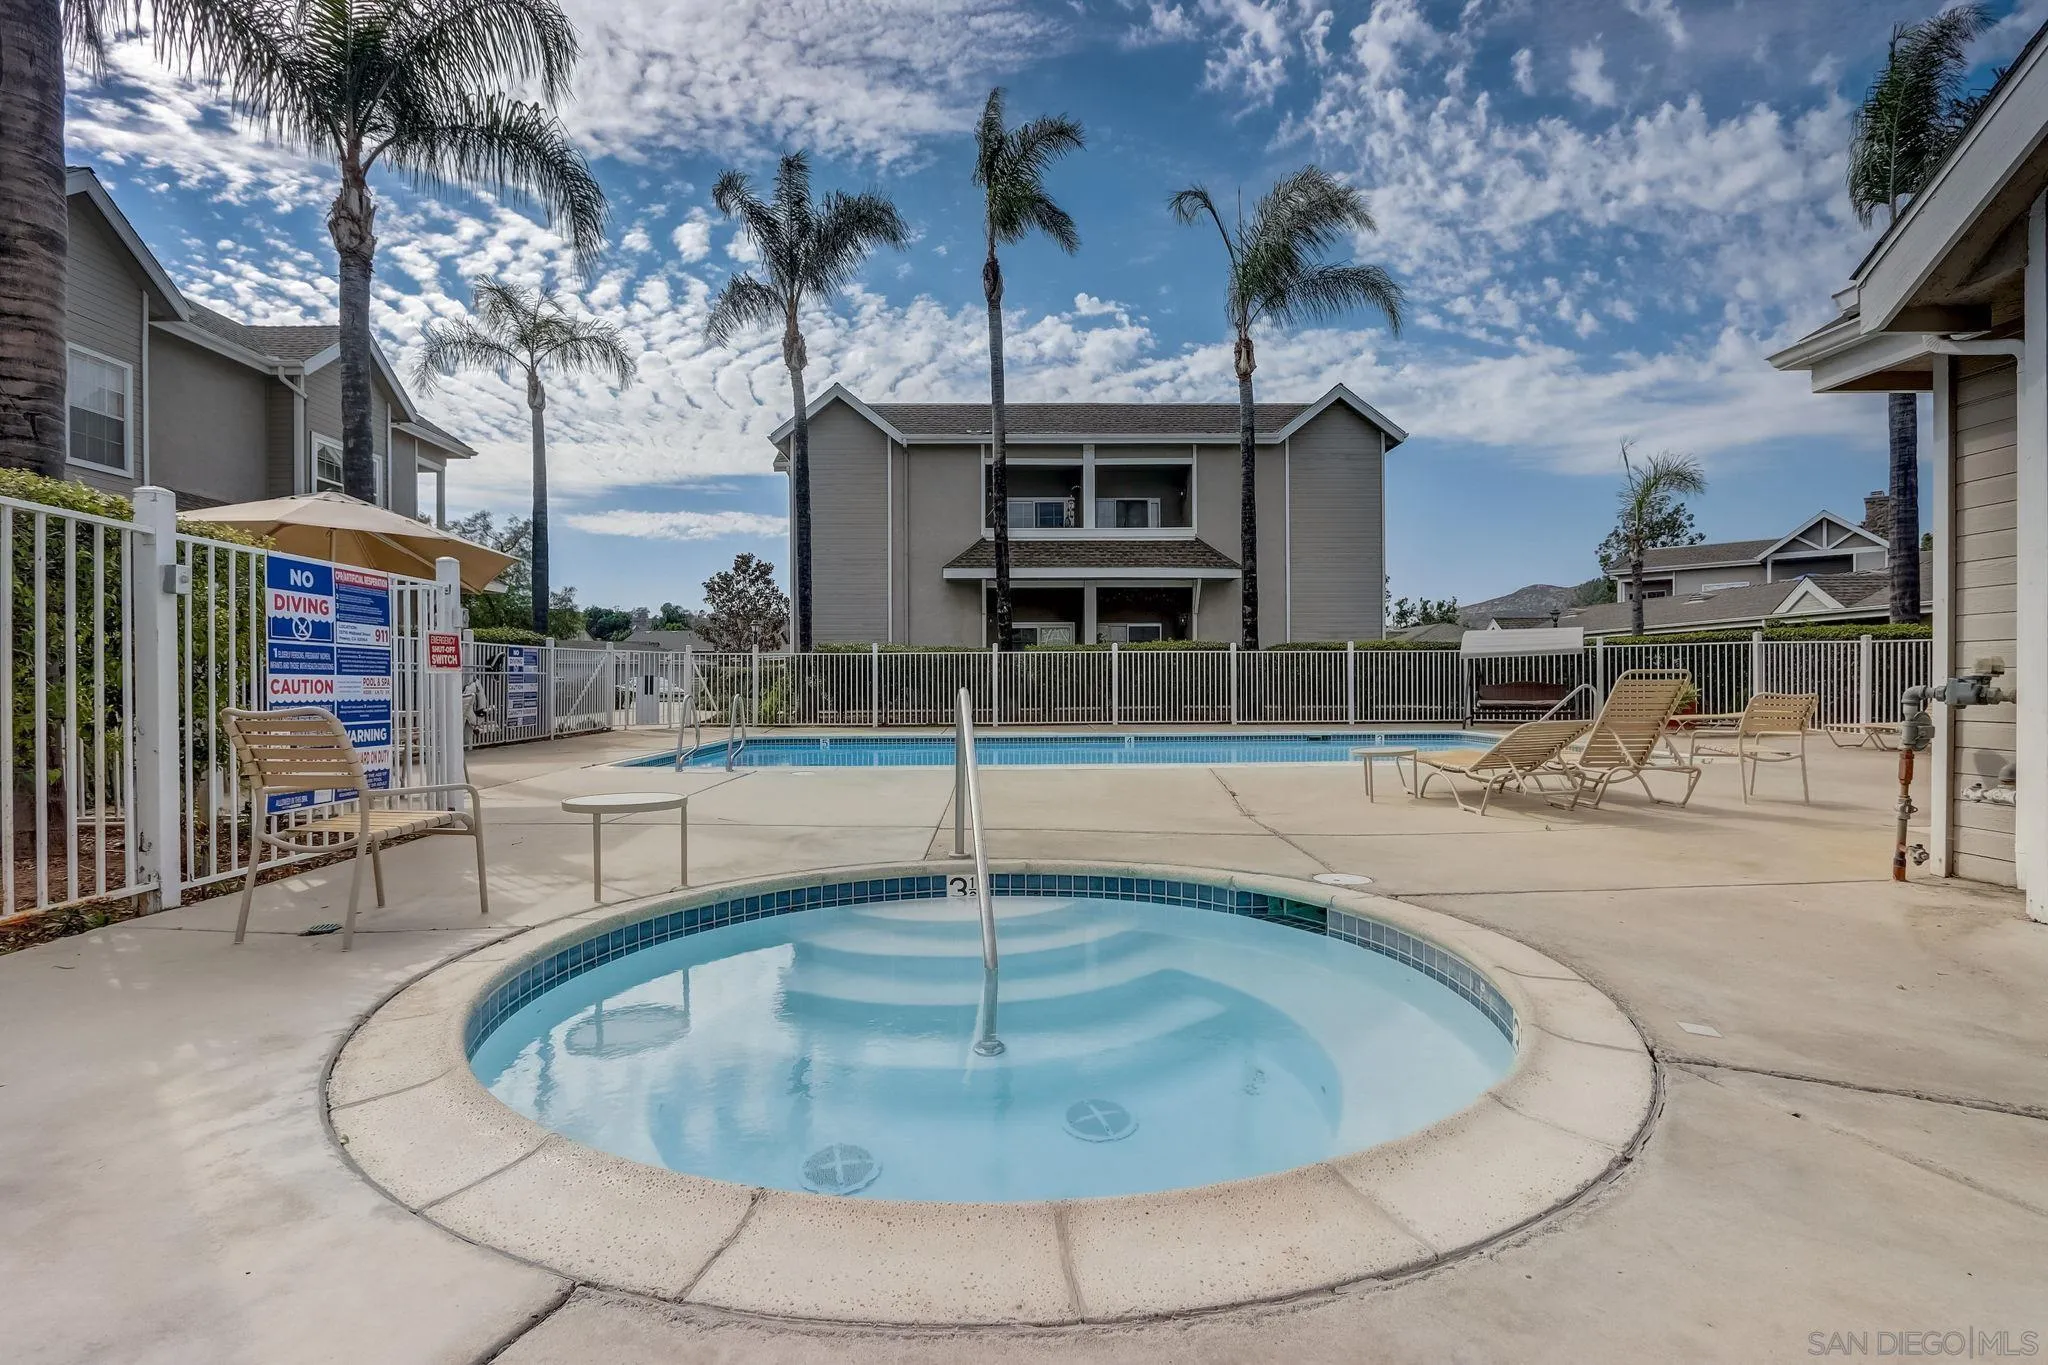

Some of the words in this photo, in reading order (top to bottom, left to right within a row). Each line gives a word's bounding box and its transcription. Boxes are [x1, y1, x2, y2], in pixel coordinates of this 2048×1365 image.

[290, 569, 314, 588] NO
[274, 593, 330, 616] DIVING
[375, 628, 389, 643] 911
[430, 635, 456, 645] EMERGENCY
[273, 647, 278, 659] 1
[431, 645, 456, 654] SHUT-OFF
[431, 654, 458, 665] SWITCH
[270, 678, 334, 695] CAUTION
[362, 677, 376, 687] POOL
[381, 677, 391, 687] SPA
